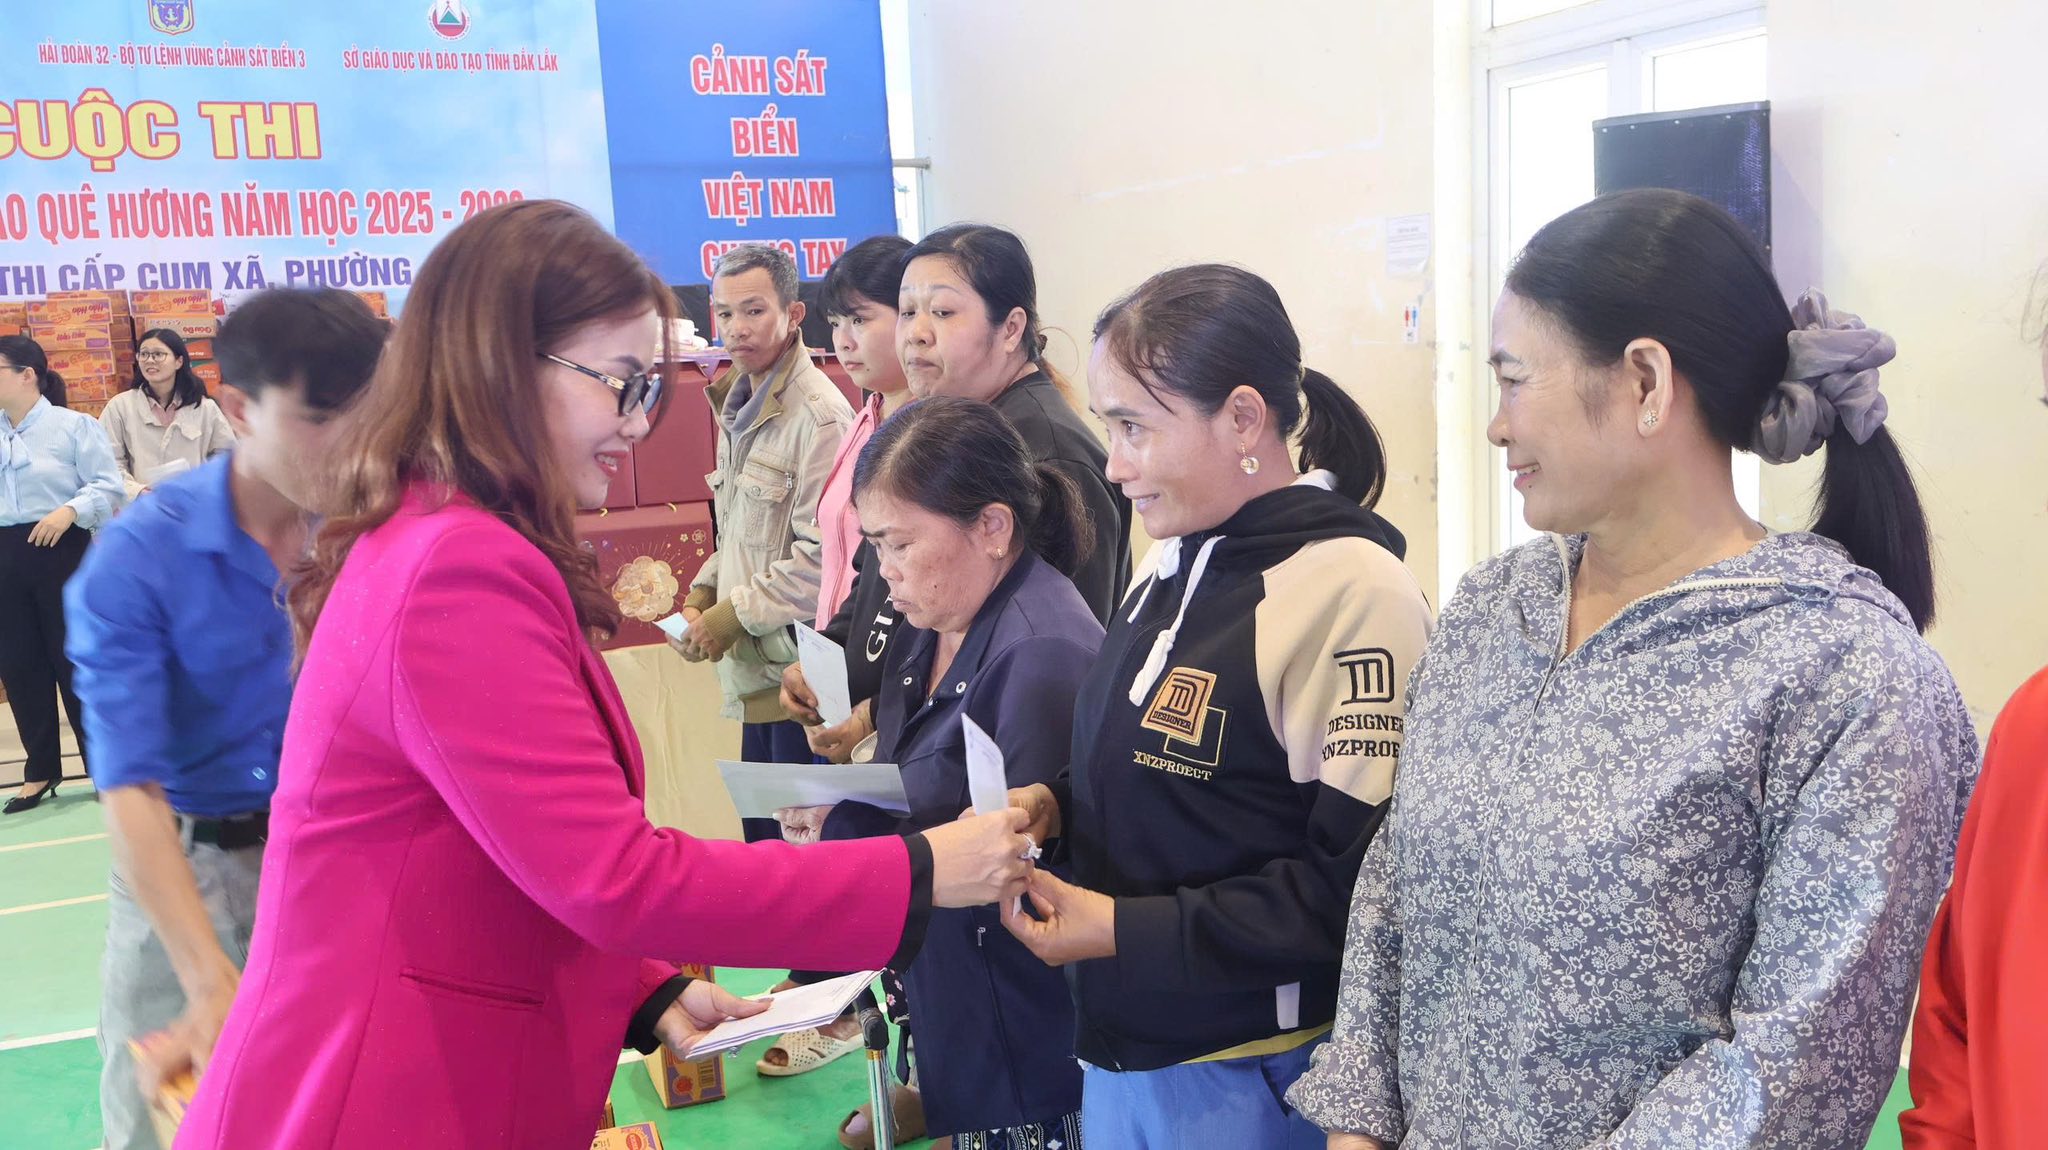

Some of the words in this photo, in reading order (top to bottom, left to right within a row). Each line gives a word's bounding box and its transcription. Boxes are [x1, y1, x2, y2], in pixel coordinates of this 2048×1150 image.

[39, 39, 59, 63] HẢI
[61, 41, 92, 64] ĐOÀN
[95, 45, 109, 64] 32
[120, 42, 135, 69] BỘ
[137, 44, 152, 65] TƯ
[154, 42, 182, 69] LỆNH
[184, 43, 214, 66] VÙNG
[217, 41, 246, 67] CẢNH
[249, 44, 268, 67] SÁT
[271, 42, 296, 68] BIỂN
[298, 49, 306, 67] 3
[344, 44, 359, 68] SỞ
[363, 48, 389, 69] GIÁO
[392, 51, 415, 72] DỤC
[418, 48, 433, 69] VÀ
[436, 49, 458, 70] ĐÀO
[461, 52, 482, 74] TẠO
[485, 48, 510, 70] TỈNH
[513, 48, 535, 71] ĐẮK
[538, 48, 558, 71] LẮK
[692, 45, 768, 93] CẢNH
[777, 50, 825, 94] SÁT
[198, 101, 323, 160] THI
[733, 105, 798, 155] BIỂN
[37, 183, 100, 245] QUÊ
[107, 188, 214, 238] HƯƠNG
[221, 182, 292, 236] NĂM
[299, 191, 358, 245] HỌC
[366, 191, 434, 234] 2025
[703, 174, 762, 224] VIỆT
[770, 180, 834, 216] NAM
[58, 252, 125, 291] CẤP
[285, 252, 412, 288] PHƯỜNG
[1152, 711, 1192, 729] DESIGNER
[1133, 750, 1212, 780] XNZPROECT
